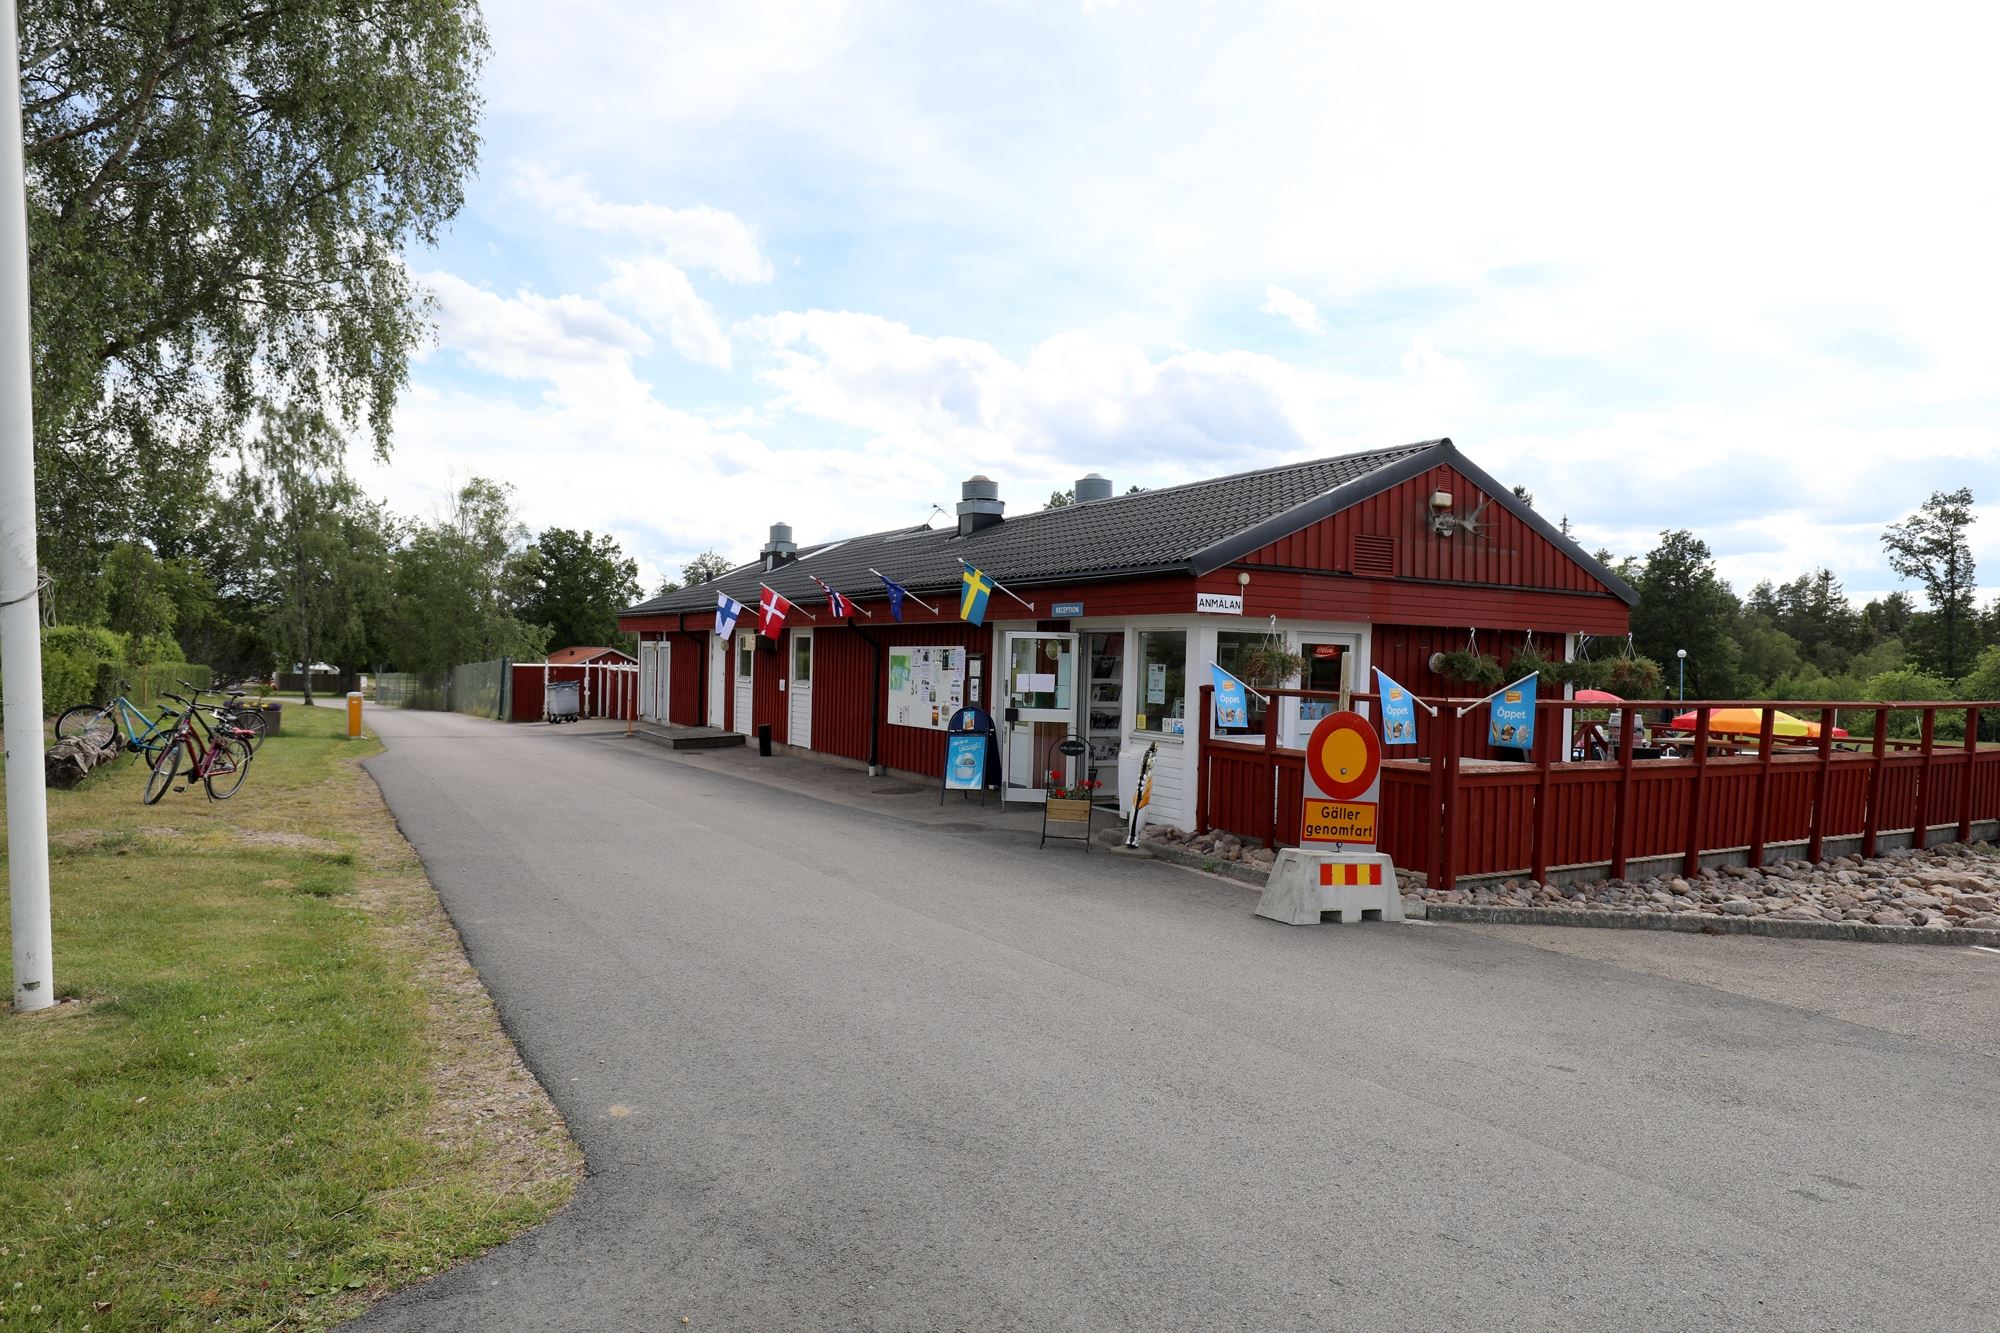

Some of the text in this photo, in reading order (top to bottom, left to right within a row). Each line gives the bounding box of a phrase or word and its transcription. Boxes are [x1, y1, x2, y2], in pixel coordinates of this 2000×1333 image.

[1055, 606, 1080, 614] RECEPTION
[1199, 596, 1241, 610] ANMÄLAN
[1220, 693, 1240, 705] Öppet
[1386, 703, 1409, 717] Öppet
[1497, 705, 1527, 720] Öppet
[1321, 806, 1361, 820] Gäller
[1306, 824, 1373, 837] genomfart
